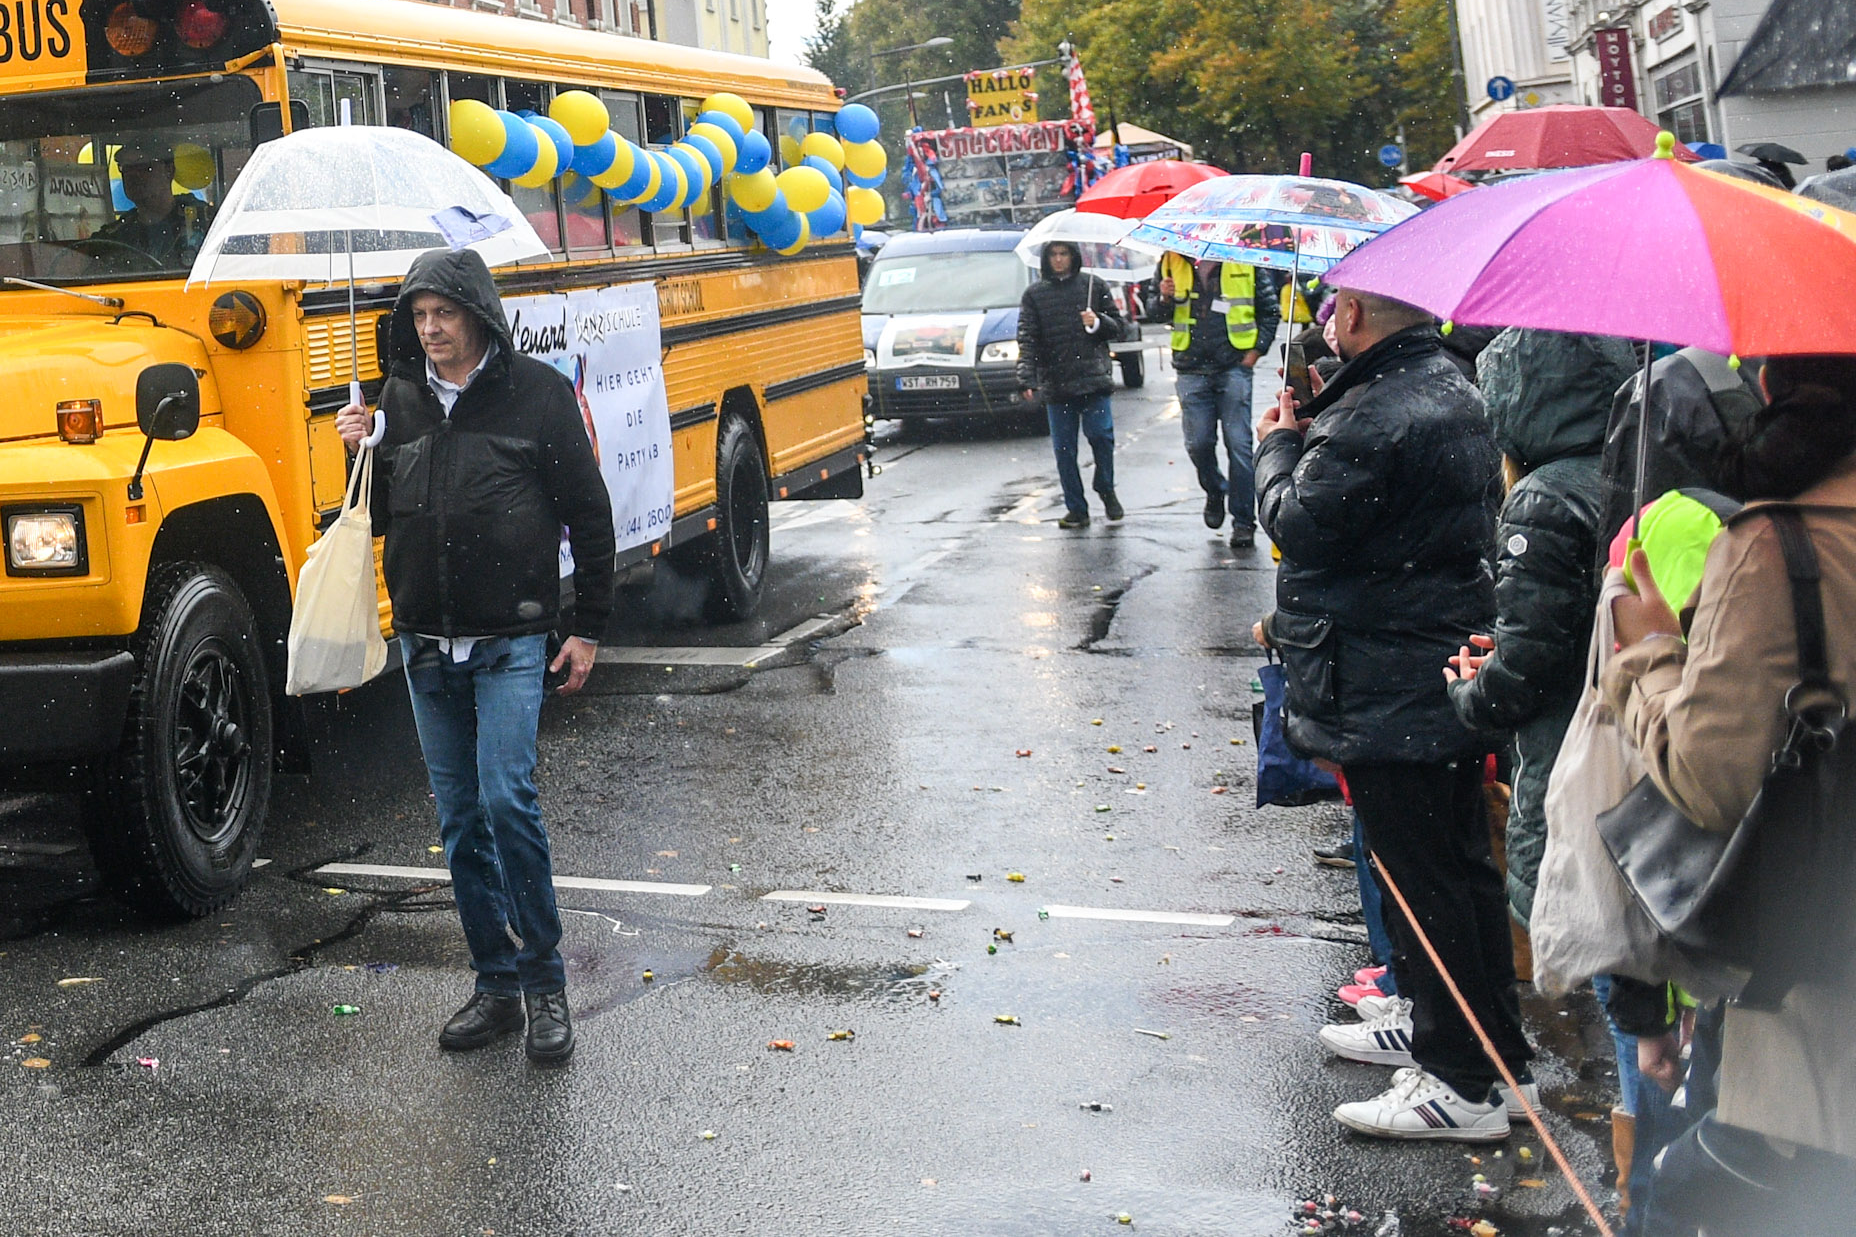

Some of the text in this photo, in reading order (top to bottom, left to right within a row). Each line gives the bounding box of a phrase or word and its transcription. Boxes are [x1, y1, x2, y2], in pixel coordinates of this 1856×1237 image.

[971, 75, 1030, 93] HALLO
[596, 366, 655, 393] HIER GEHT
[901, 375, 957, 388] WST RH 759
[626, 409, 643, 428] DIE
[618, 446, 646, 472] PARTY
